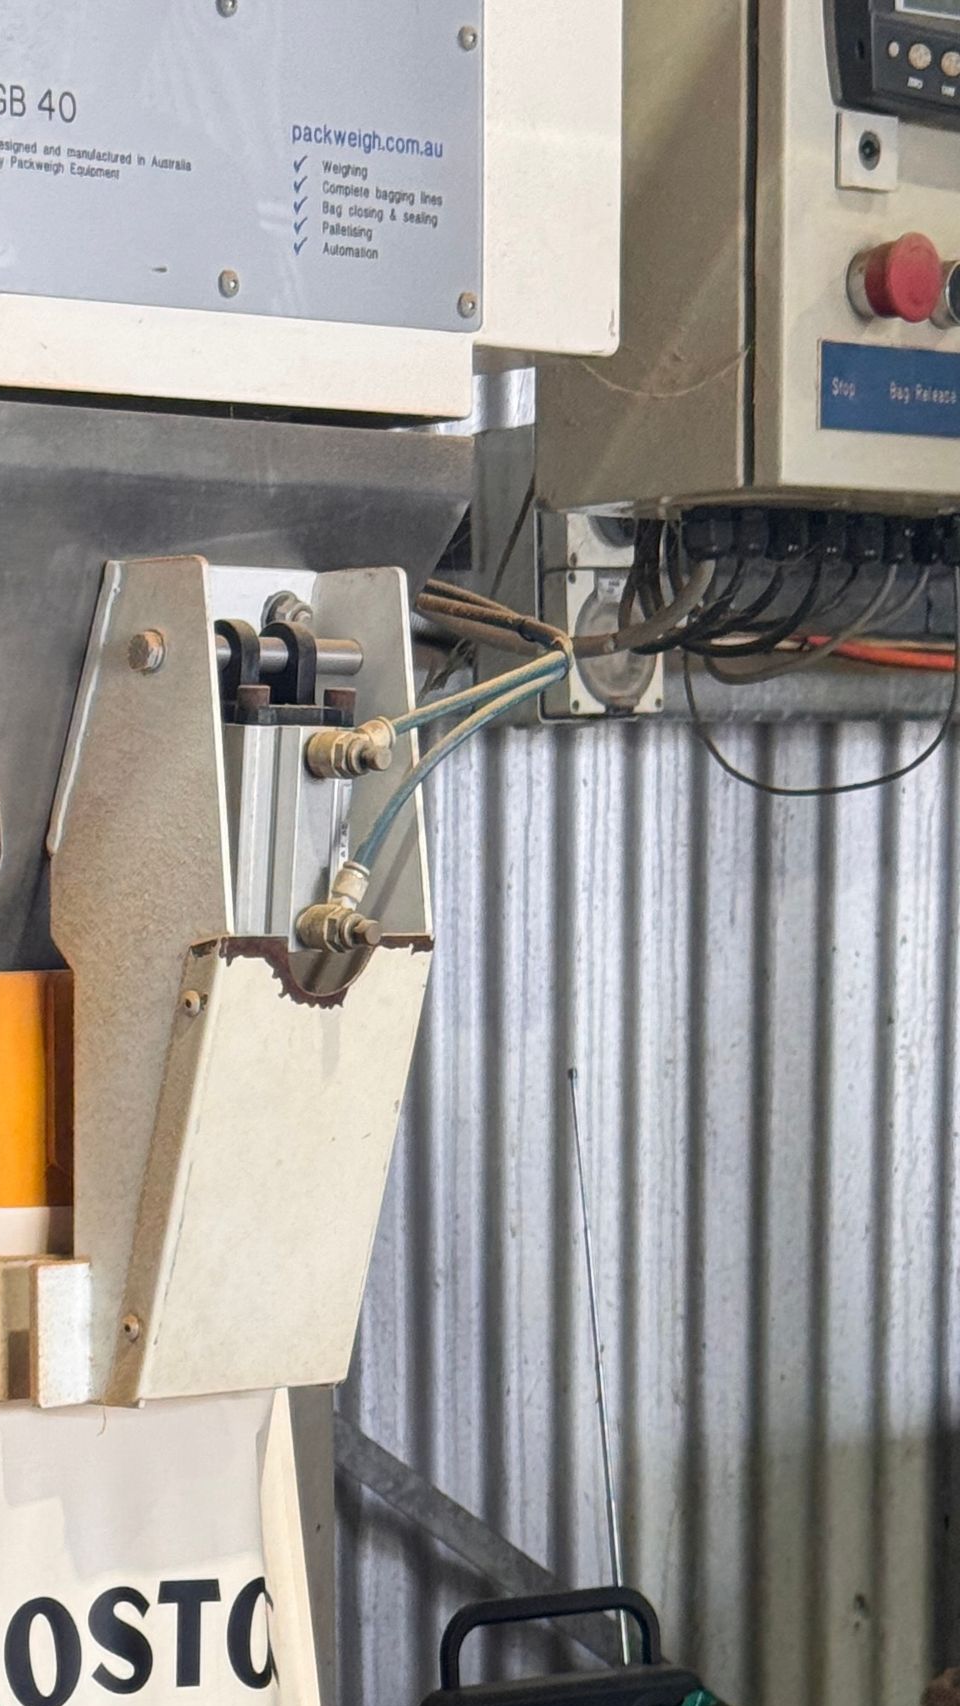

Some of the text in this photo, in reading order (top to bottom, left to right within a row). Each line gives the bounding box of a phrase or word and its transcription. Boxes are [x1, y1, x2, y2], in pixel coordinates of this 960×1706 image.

[37, 89, 77, 123] 40
[292, 124, 443, 158] packweigh.com.au
[10, 156, 65, 177] Packweigh
[70, 162, 120, 180] Equipment
[43, 144, 61, 157] and
[67, 147, 132, 165] manufactured
[137, 155, 145, 166] in
[151, 155, 192, 172] Australia
[322, 160, 368, 180] Weighing
[322, 180, 443, 207] Complete bagging lines
[322, 201, 438, 229] Bag closing & sealing
[322, 221, 373, 242] Palletising
[322, 241, 379, 259] Automation
[831, 376, 856, 400] Stop
[890, 381, 910, 404] Bag
